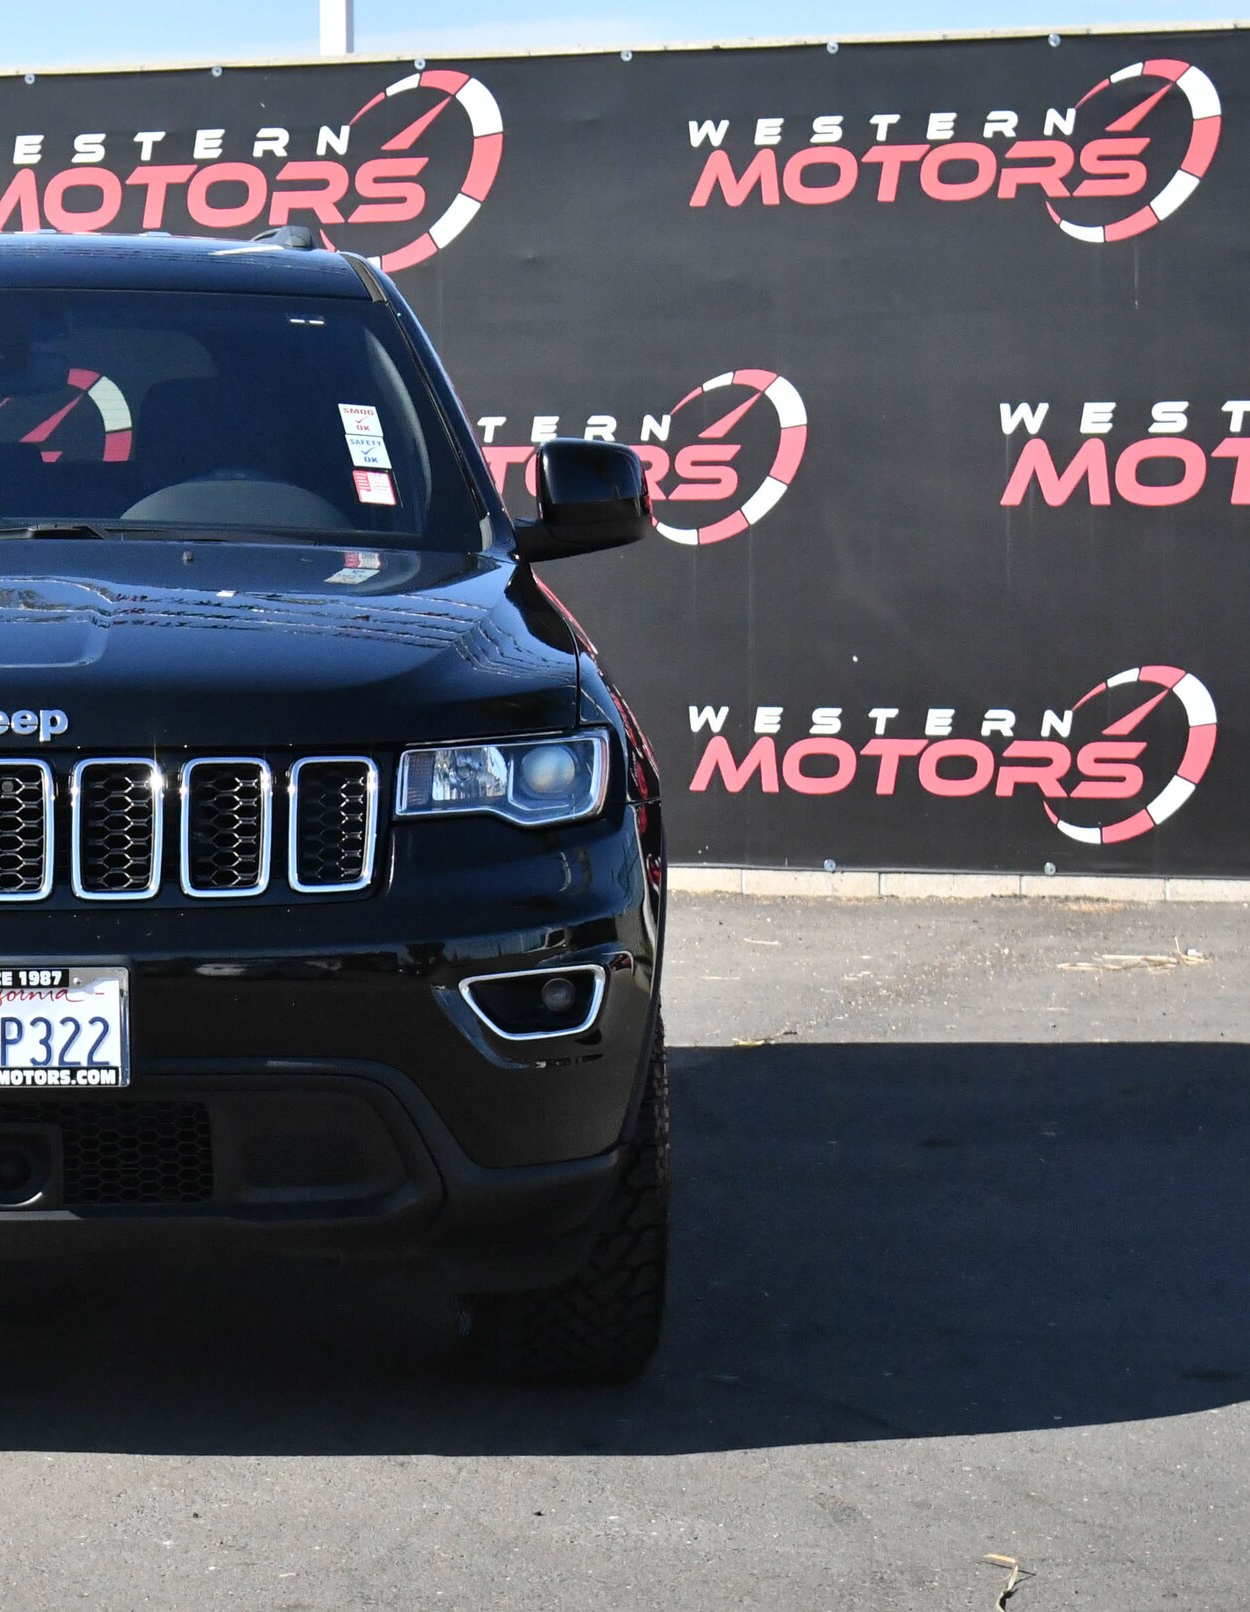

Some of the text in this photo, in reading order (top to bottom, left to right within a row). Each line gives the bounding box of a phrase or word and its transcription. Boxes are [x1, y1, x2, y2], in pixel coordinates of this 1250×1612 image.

[689, 108, 1076, 147] WESTERN
[690, 137, 1151, 206] MOTORS
[343, 407, 374, 416] SMOG
[350, 439, 382, 447] SAFETY
[363, 456, 379, 464] OK
[689, 706, 1073, 738] WESTERN
[690, 736, 1147, 799] MOTORS
[19, 971, 62, 986] 1987
